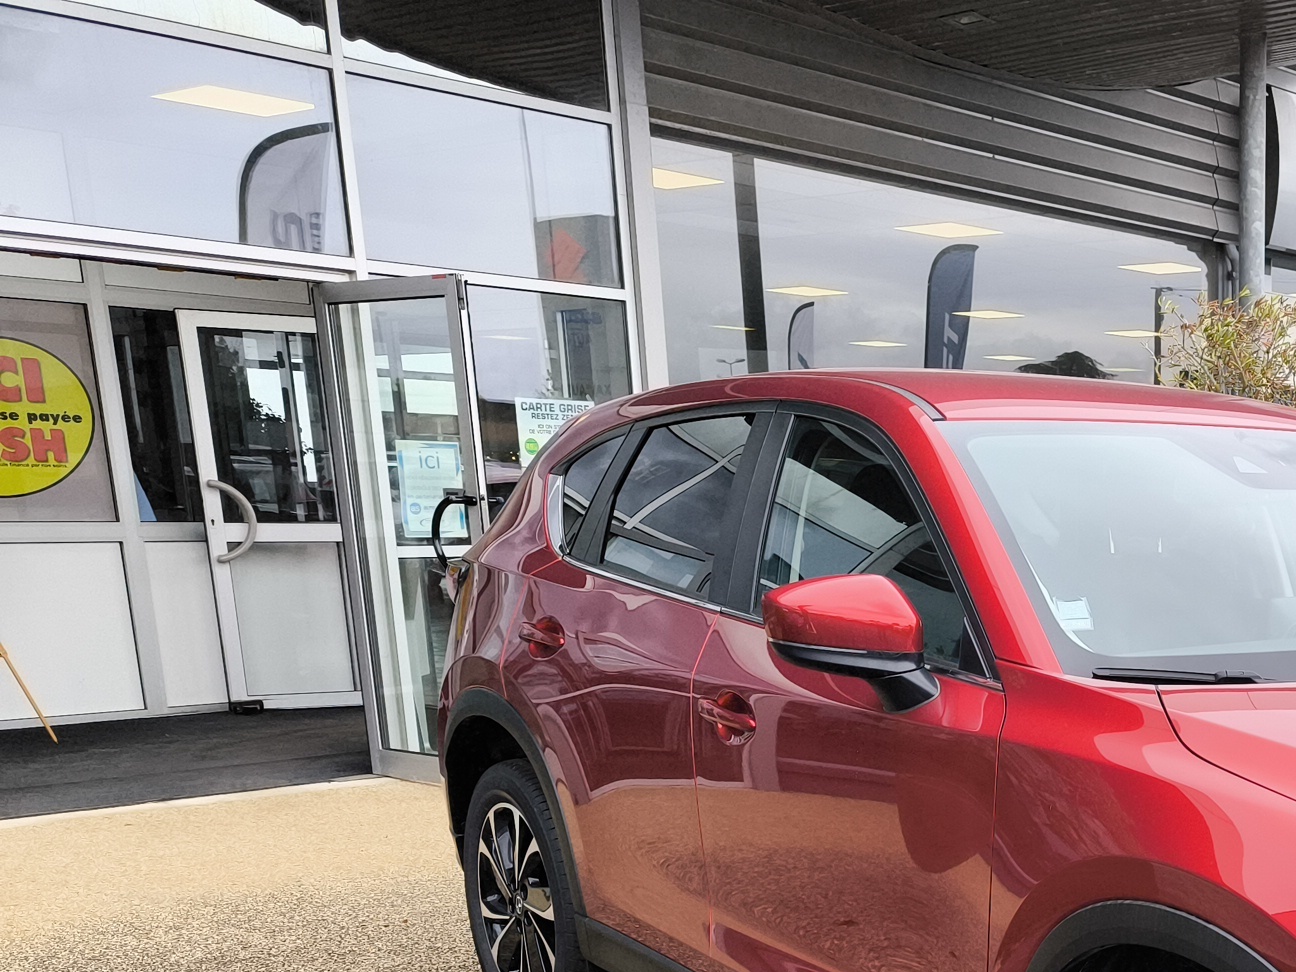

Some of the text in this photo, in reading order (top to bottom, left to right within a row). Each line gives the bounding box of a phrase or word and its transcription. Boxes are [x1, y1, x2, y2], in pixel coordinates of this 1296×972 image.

[0, 356, 46, 403] CI
[521, 402, 556, 412] CARTE
[0, 410, 83, 425] se payée
[531, 413, 560, 421] RESTEZ
[0, 427, 68, 463] SH
[418, 450, 441, 469] ici
